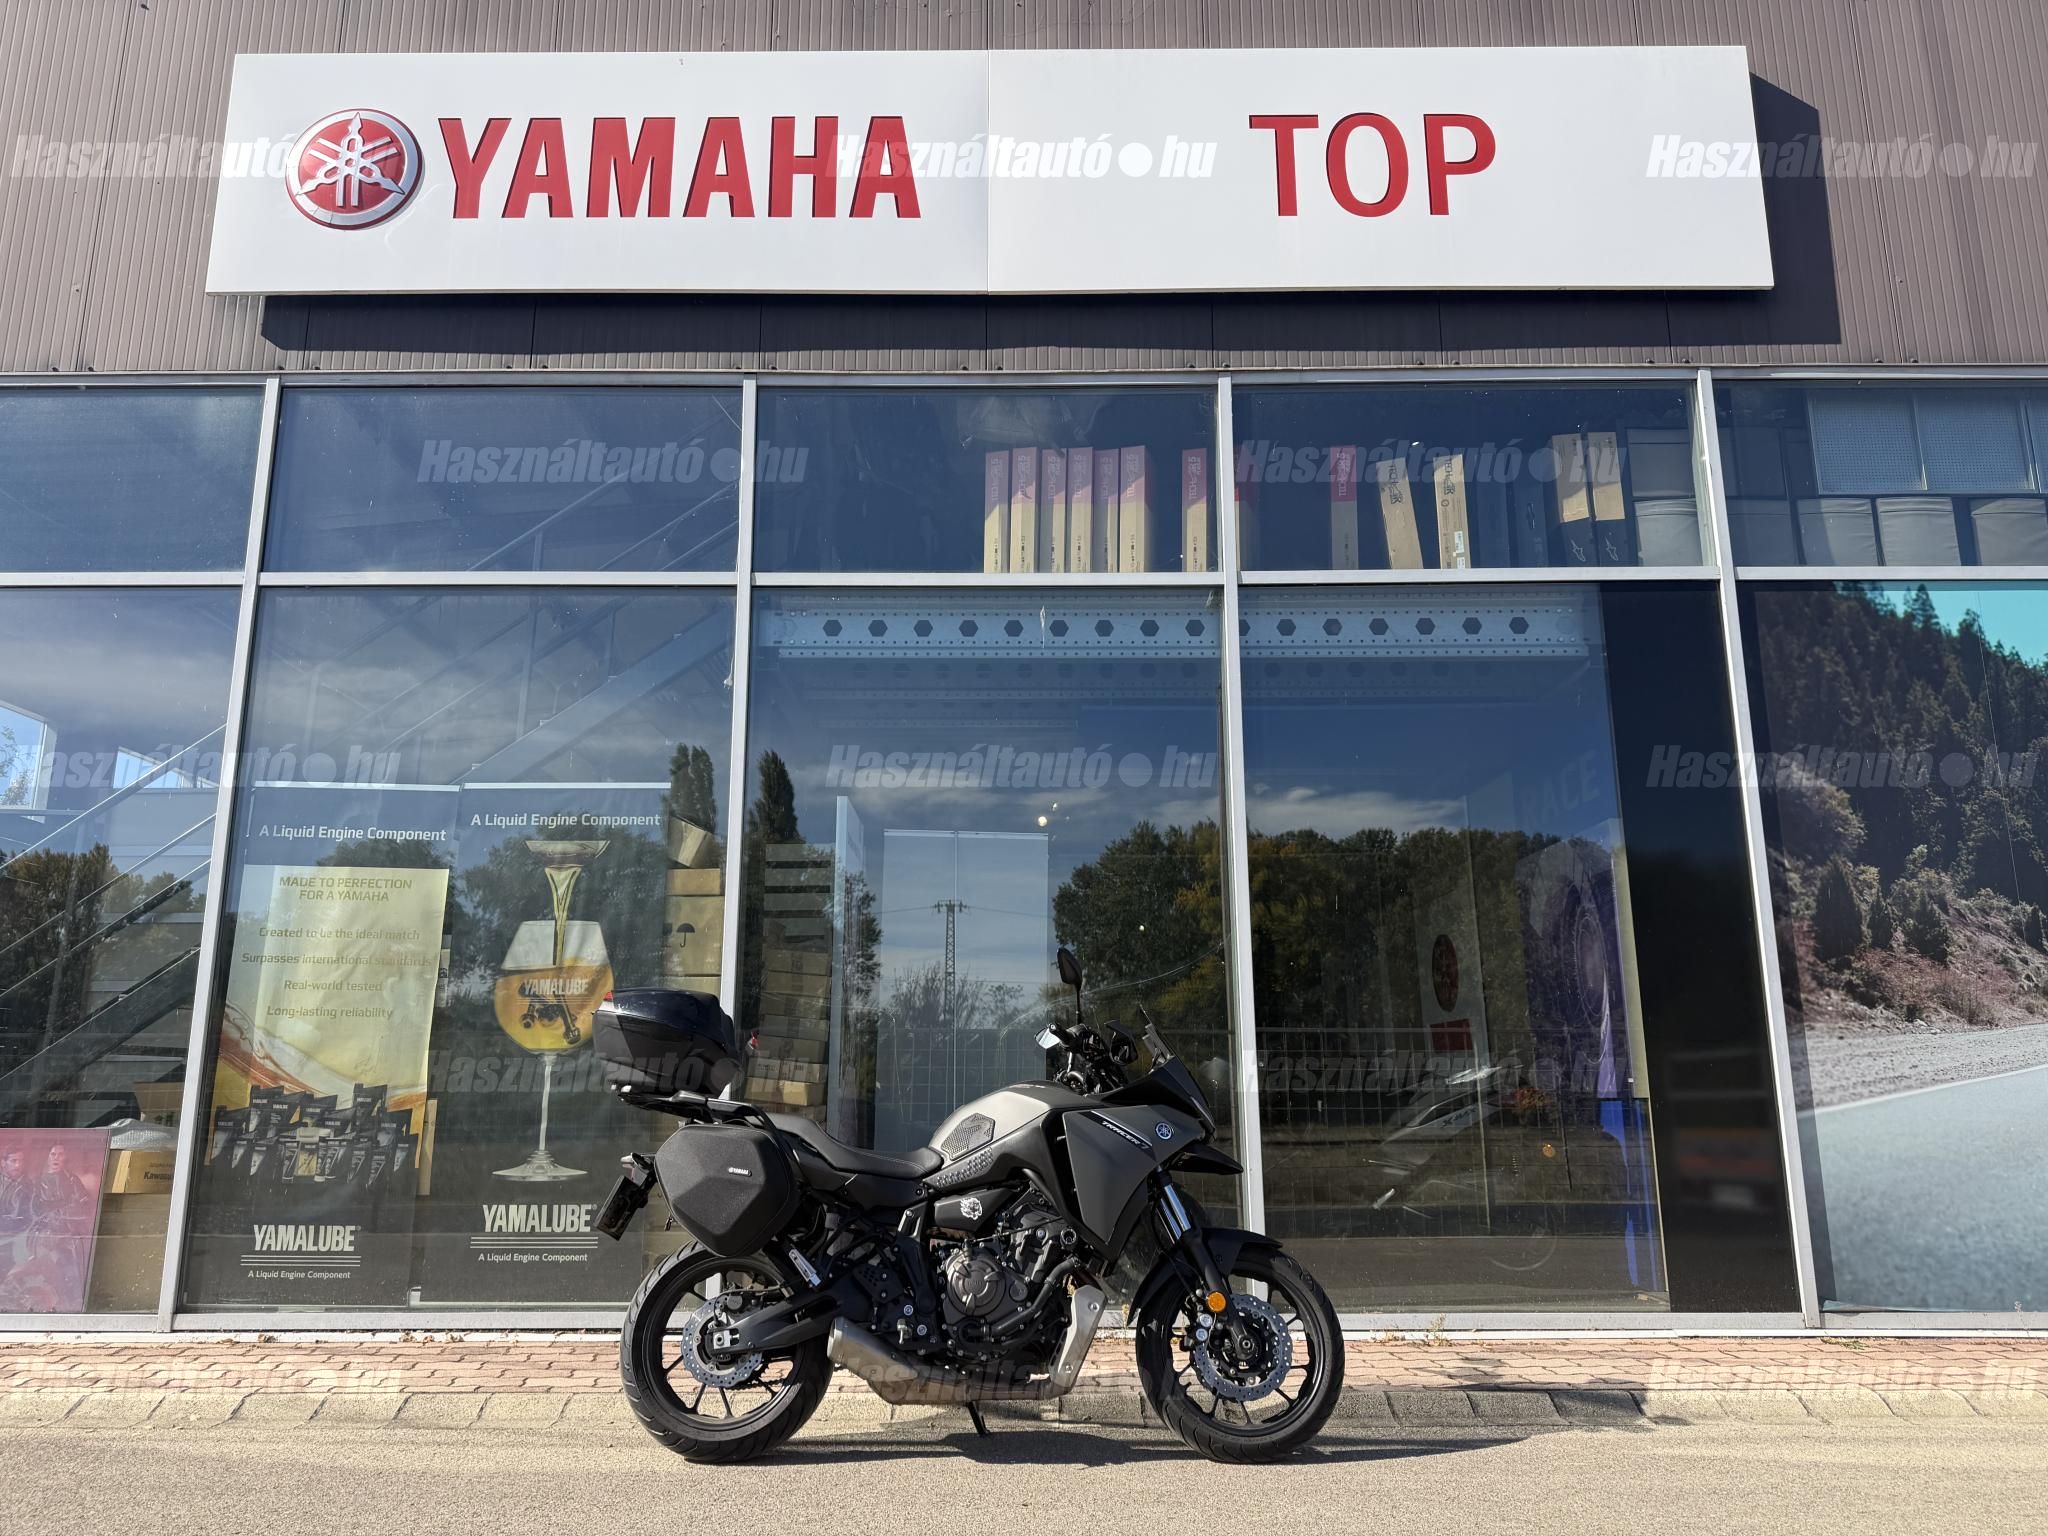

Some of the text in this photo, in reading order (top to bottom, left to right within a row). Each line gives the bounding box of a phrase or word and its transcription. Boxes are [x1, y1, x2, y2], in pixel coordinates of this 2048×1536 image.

[437, 112, 1497, 219] YAMAHA TOP
[471, 813, 661, 829] A Liquid Engine Component
[259, 825, 447, 842] A Liquid Engine Component
[279, 876, 413, 889] MADE TO PERFECTION
[299, 889, 390, 902] FOR A YAMAHA
[259, 927, 303, 938] Created
[305, 928, 317, 938] to
[335, 928, 353, 939] the
[355, 928, 382, 940] ideal
[384, 929, 420, 940] match
[241, 952, 300, 965] Surpasses
[302, 953, 372, 966] international
[283, 979, 383, 992] Real-world tested
[523, 977, 590, 995] YAMALUBE
[266, 1005, 393, 1020] Long-lasting reliability
[1101, 1120, 1141, 1145] TRACER
[253, 1224, 356, 1252] YAMALUBE
[478, 1253, 588, 1264] A Liquid Engine Component
[248, 1270, 351, 1280] A Liquid Engine Component
